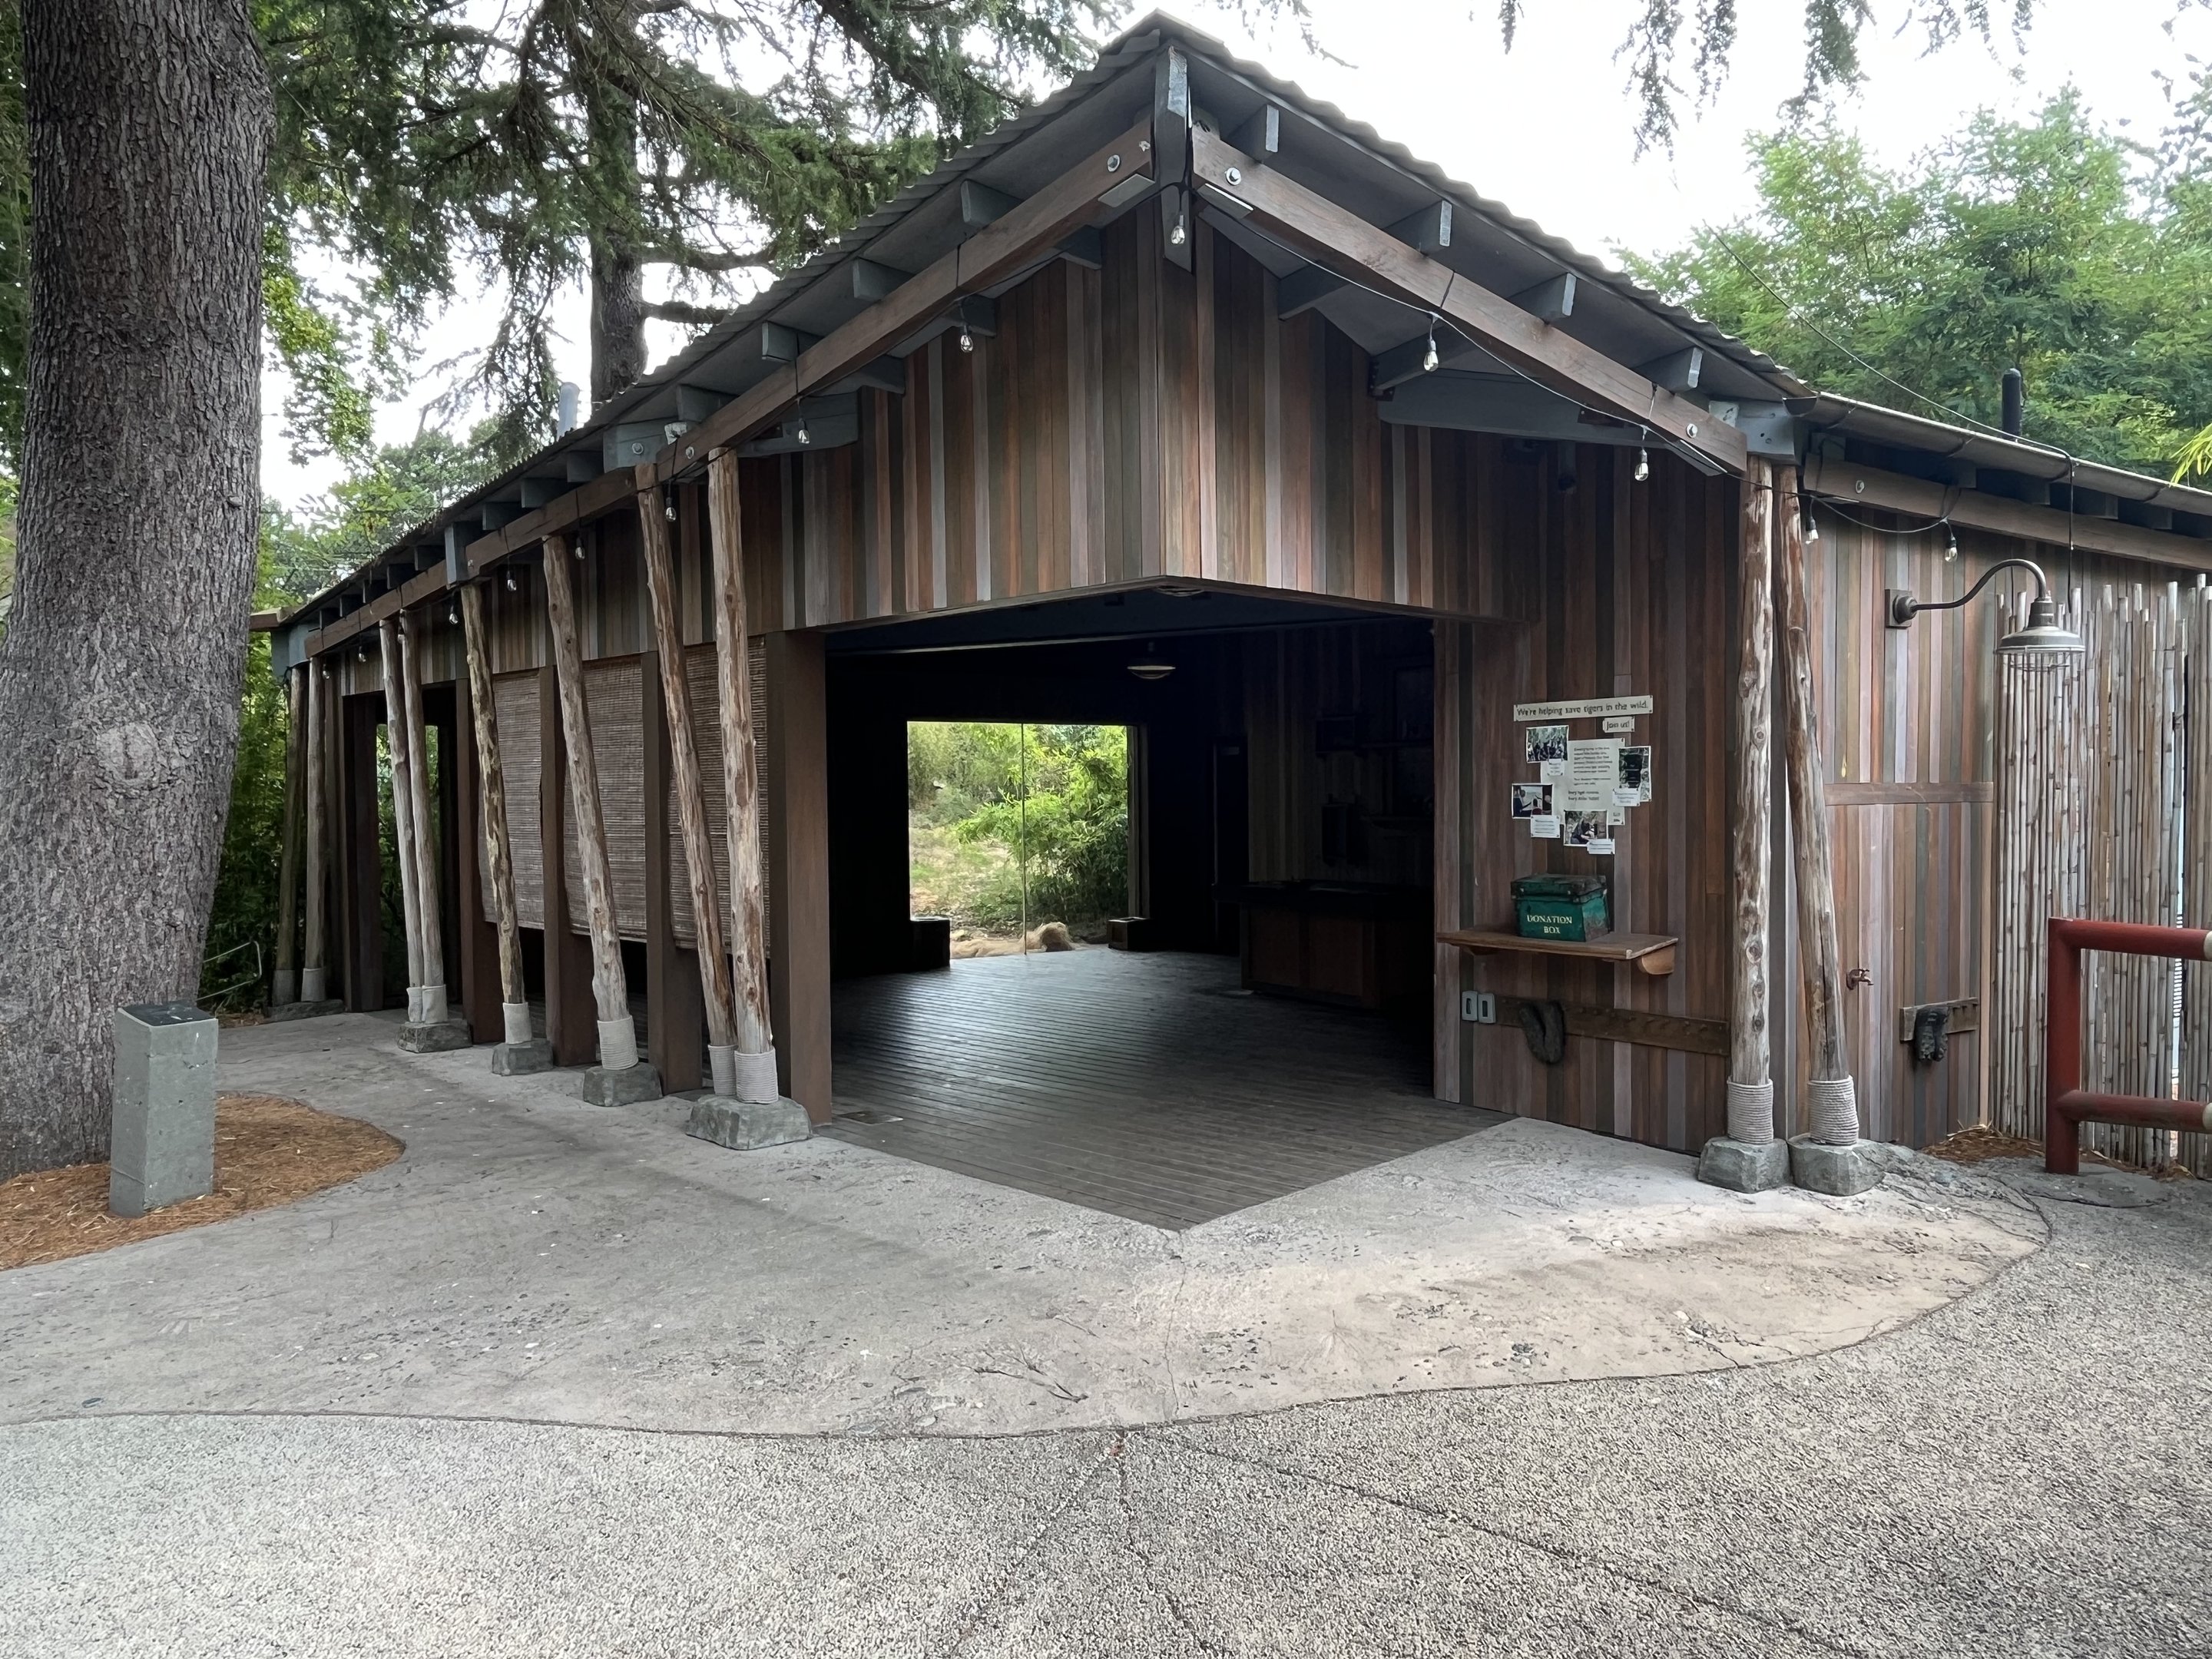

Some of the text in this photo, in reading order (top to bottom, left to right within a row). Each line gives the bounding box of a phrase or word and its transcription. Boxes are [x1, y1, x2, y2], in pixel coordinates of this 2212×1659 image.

[1517, 707, 1536, 716] We're
[1538, 707, 1562, 716] helping
[1584, 705, 1603, 714] tigers
[1606, 703, 1613, 711] in
[1614, 701, 1627, 710] the
[1606, 721, 1618, 730] Join
[1526, 914, 1573, 924] DONATION
[1544, 926, 1561, 934] BOX
